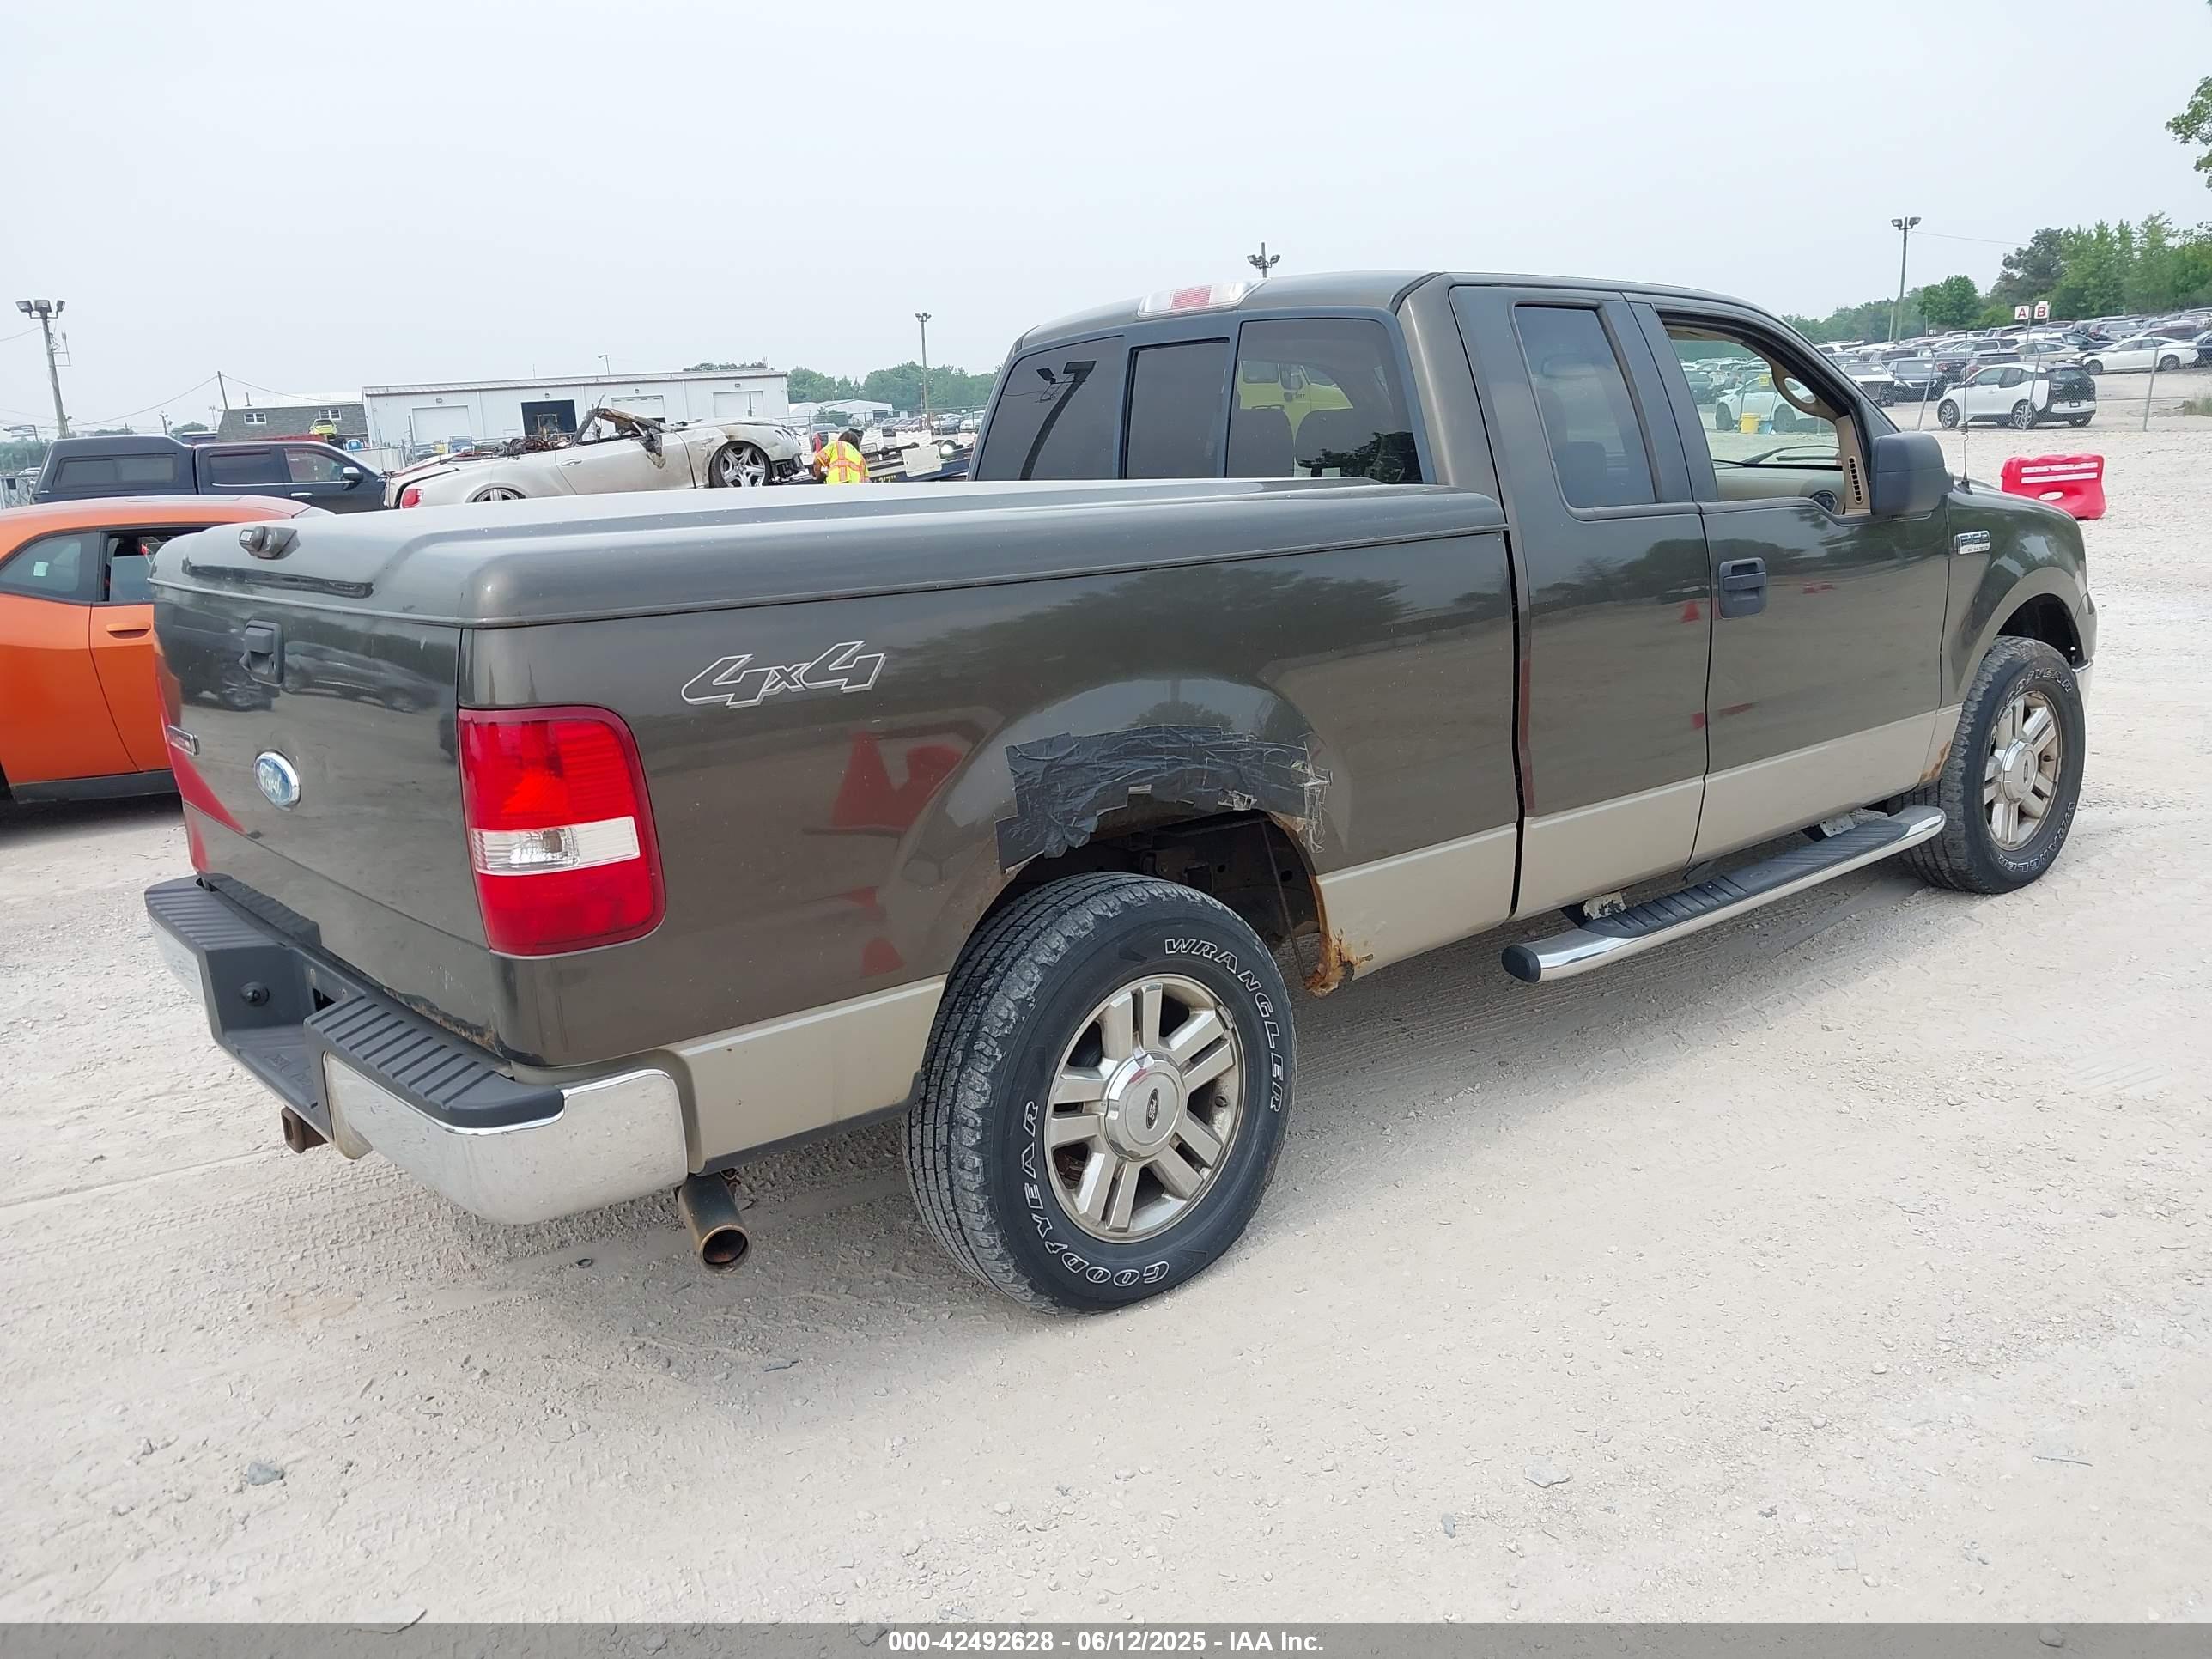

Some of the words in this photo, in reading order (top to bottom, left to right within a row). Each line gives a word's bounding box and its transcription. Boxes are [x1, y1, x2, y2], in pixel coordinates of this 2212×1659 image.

[2018, 307, 2027, 318] A
[2037, 307, 2046, 317] B
[681, 641, 886, 708] 4x4
[259, 761, 283, 798] Ford
[1998, 802, 2075, 872] WRANGLER
[1164, 938, 1285, 1114] WRANGLER
[1021, 1100, 1170, 1287] GOODYEAR
